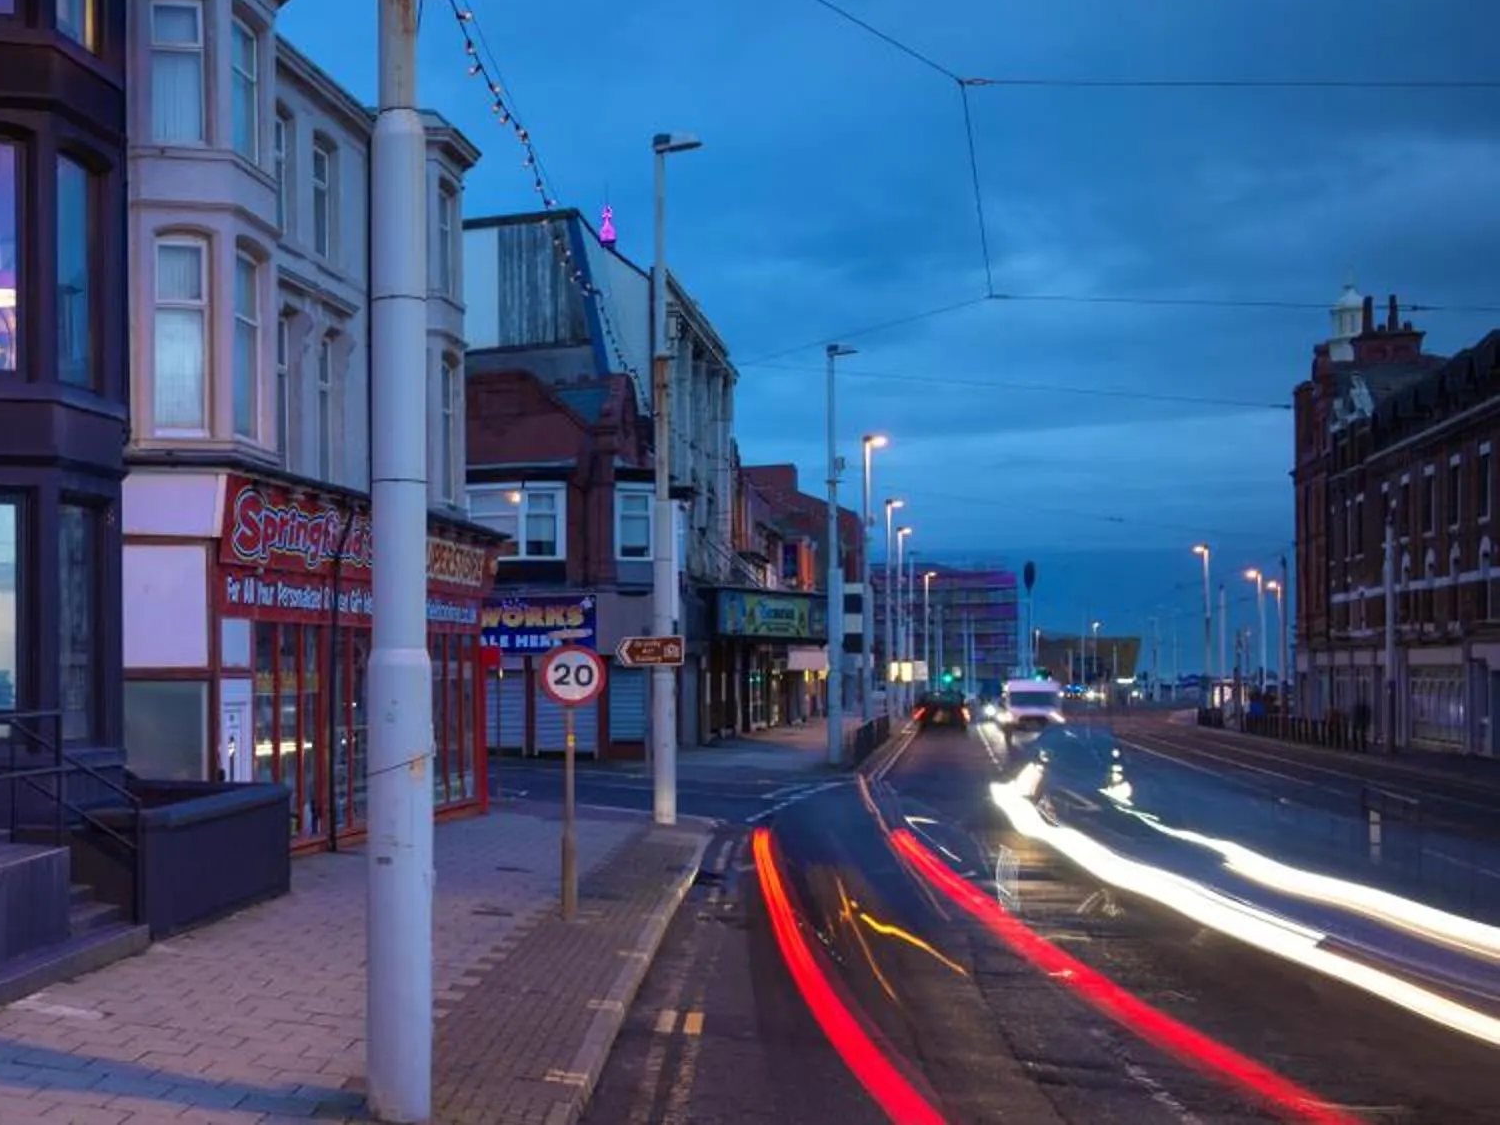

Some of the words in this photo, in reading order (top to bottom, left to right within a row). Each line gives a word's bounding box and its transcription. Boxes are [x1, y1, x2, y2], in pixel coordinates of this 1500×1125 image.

[227, 575, 241, 603] For
[243, 578, 255, 605] All
[257, 580, 275, 607] Your
[480, 604, 585, 629] WORKS
[480, 634, 509, 648] ALE
[553, 662, 595, 688] 20
